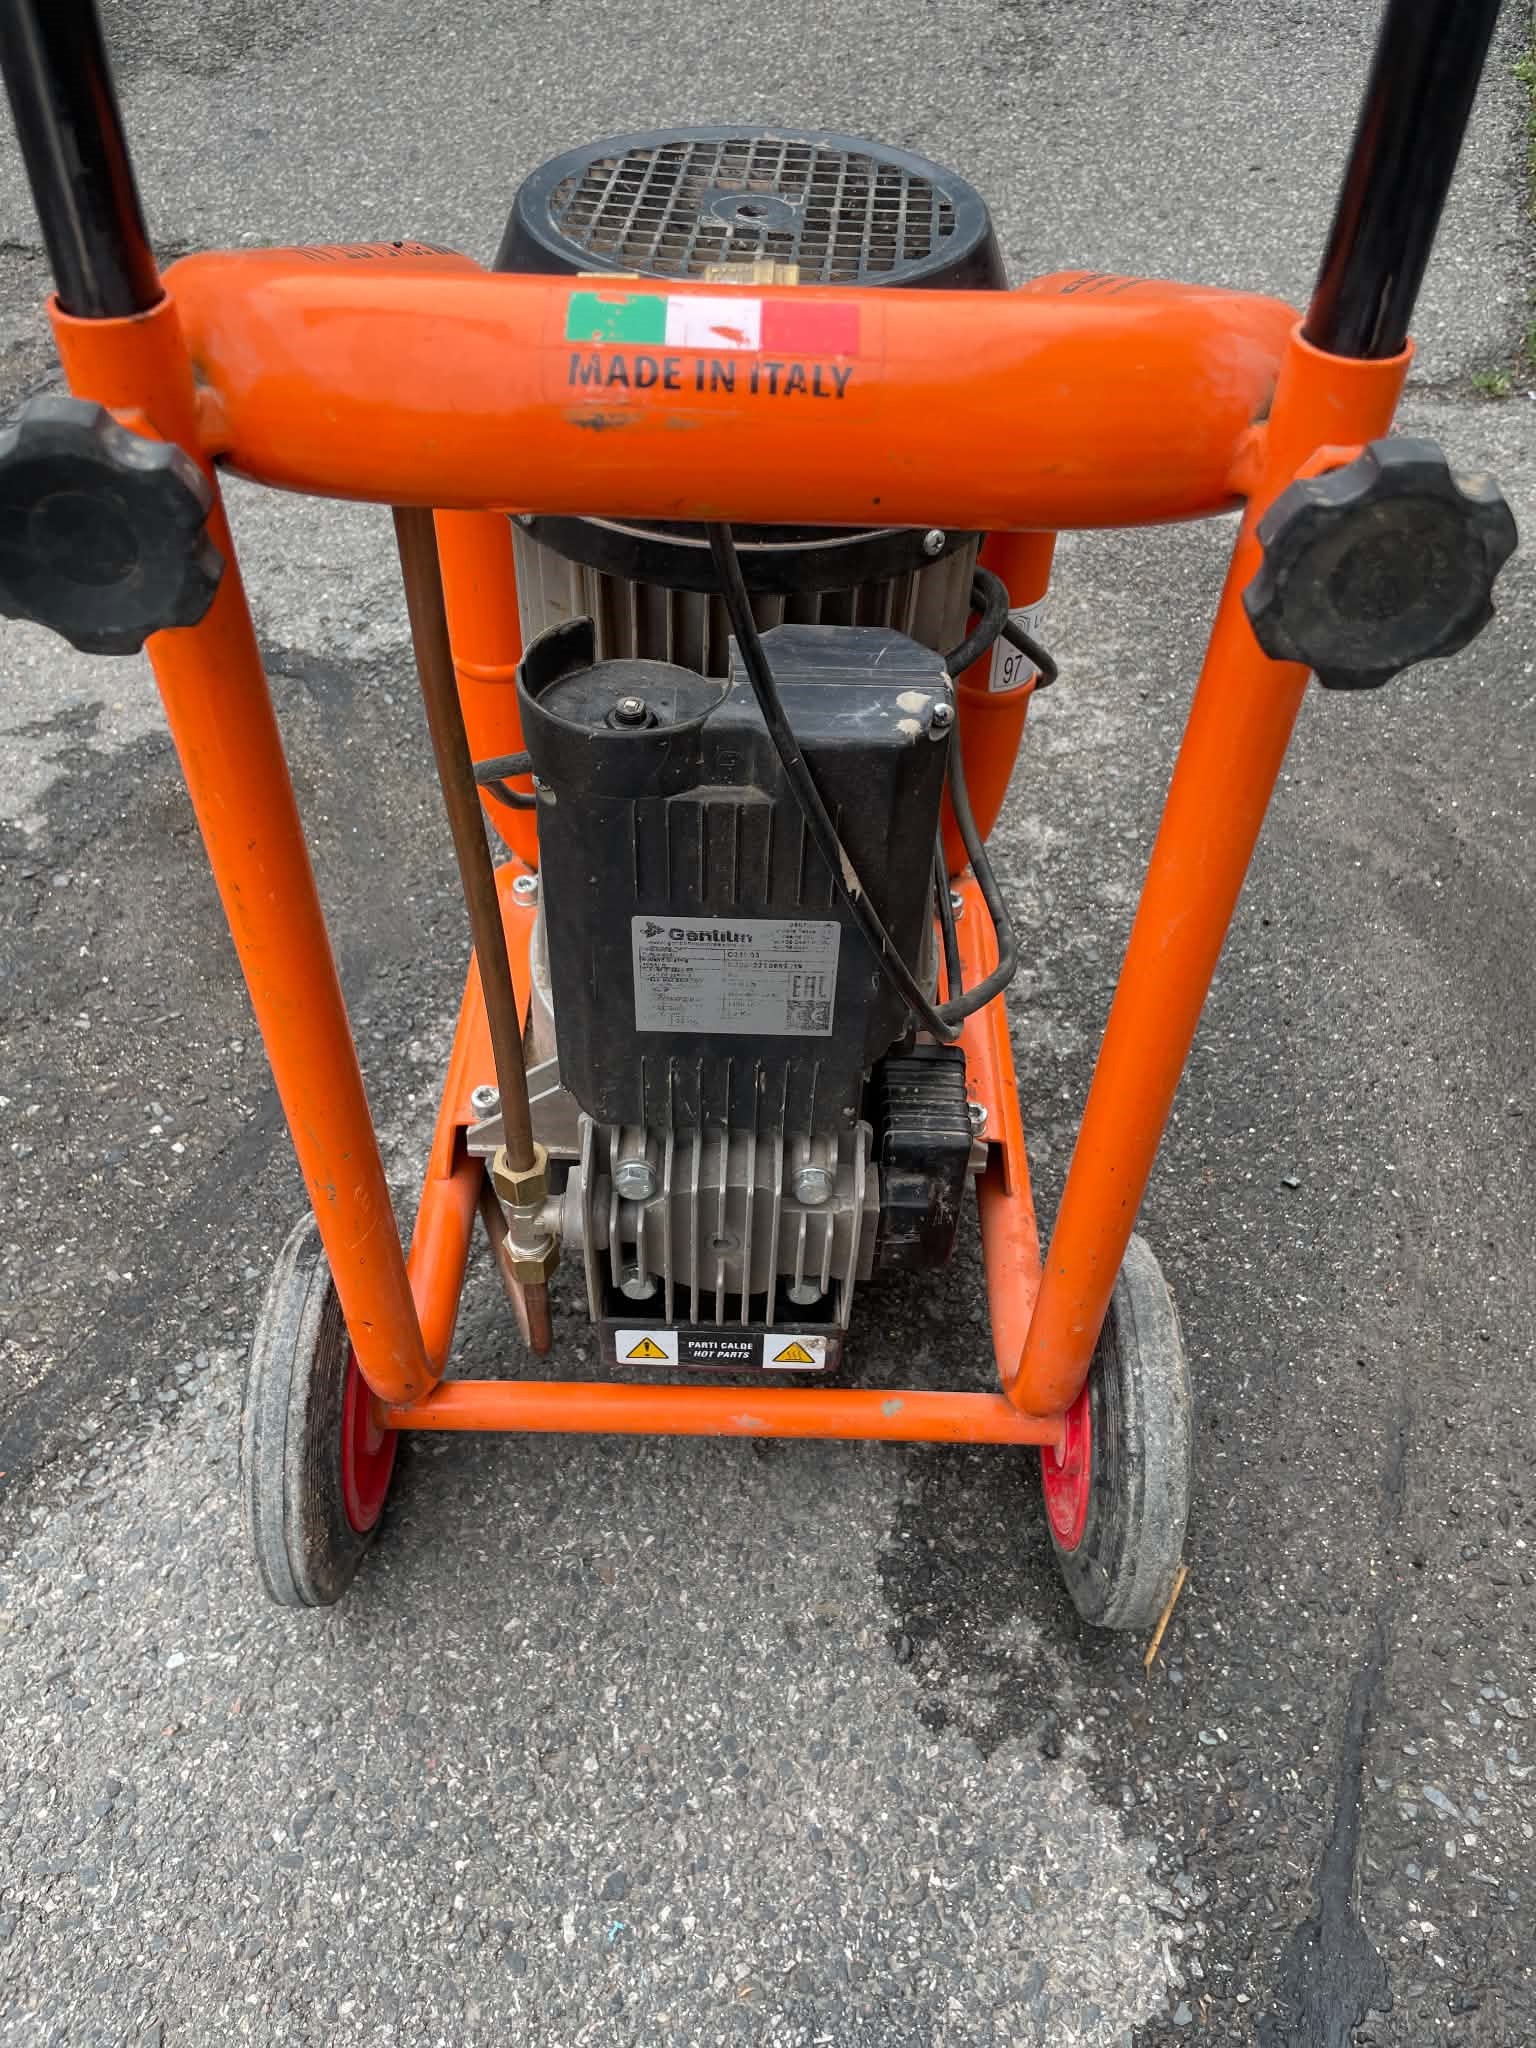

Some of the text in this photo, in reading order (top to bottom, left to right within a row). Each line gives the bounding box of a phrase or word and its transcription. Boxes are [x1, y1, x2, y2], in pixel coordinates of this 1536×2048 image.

[568, 353, 853, 399] MADE IN ITALY
[1004, 655, 1023, 684] 97
[688, 1341, 753, 1350] PARTI CALDE
[693, 1350, 750, 1359] HOT PARTS
